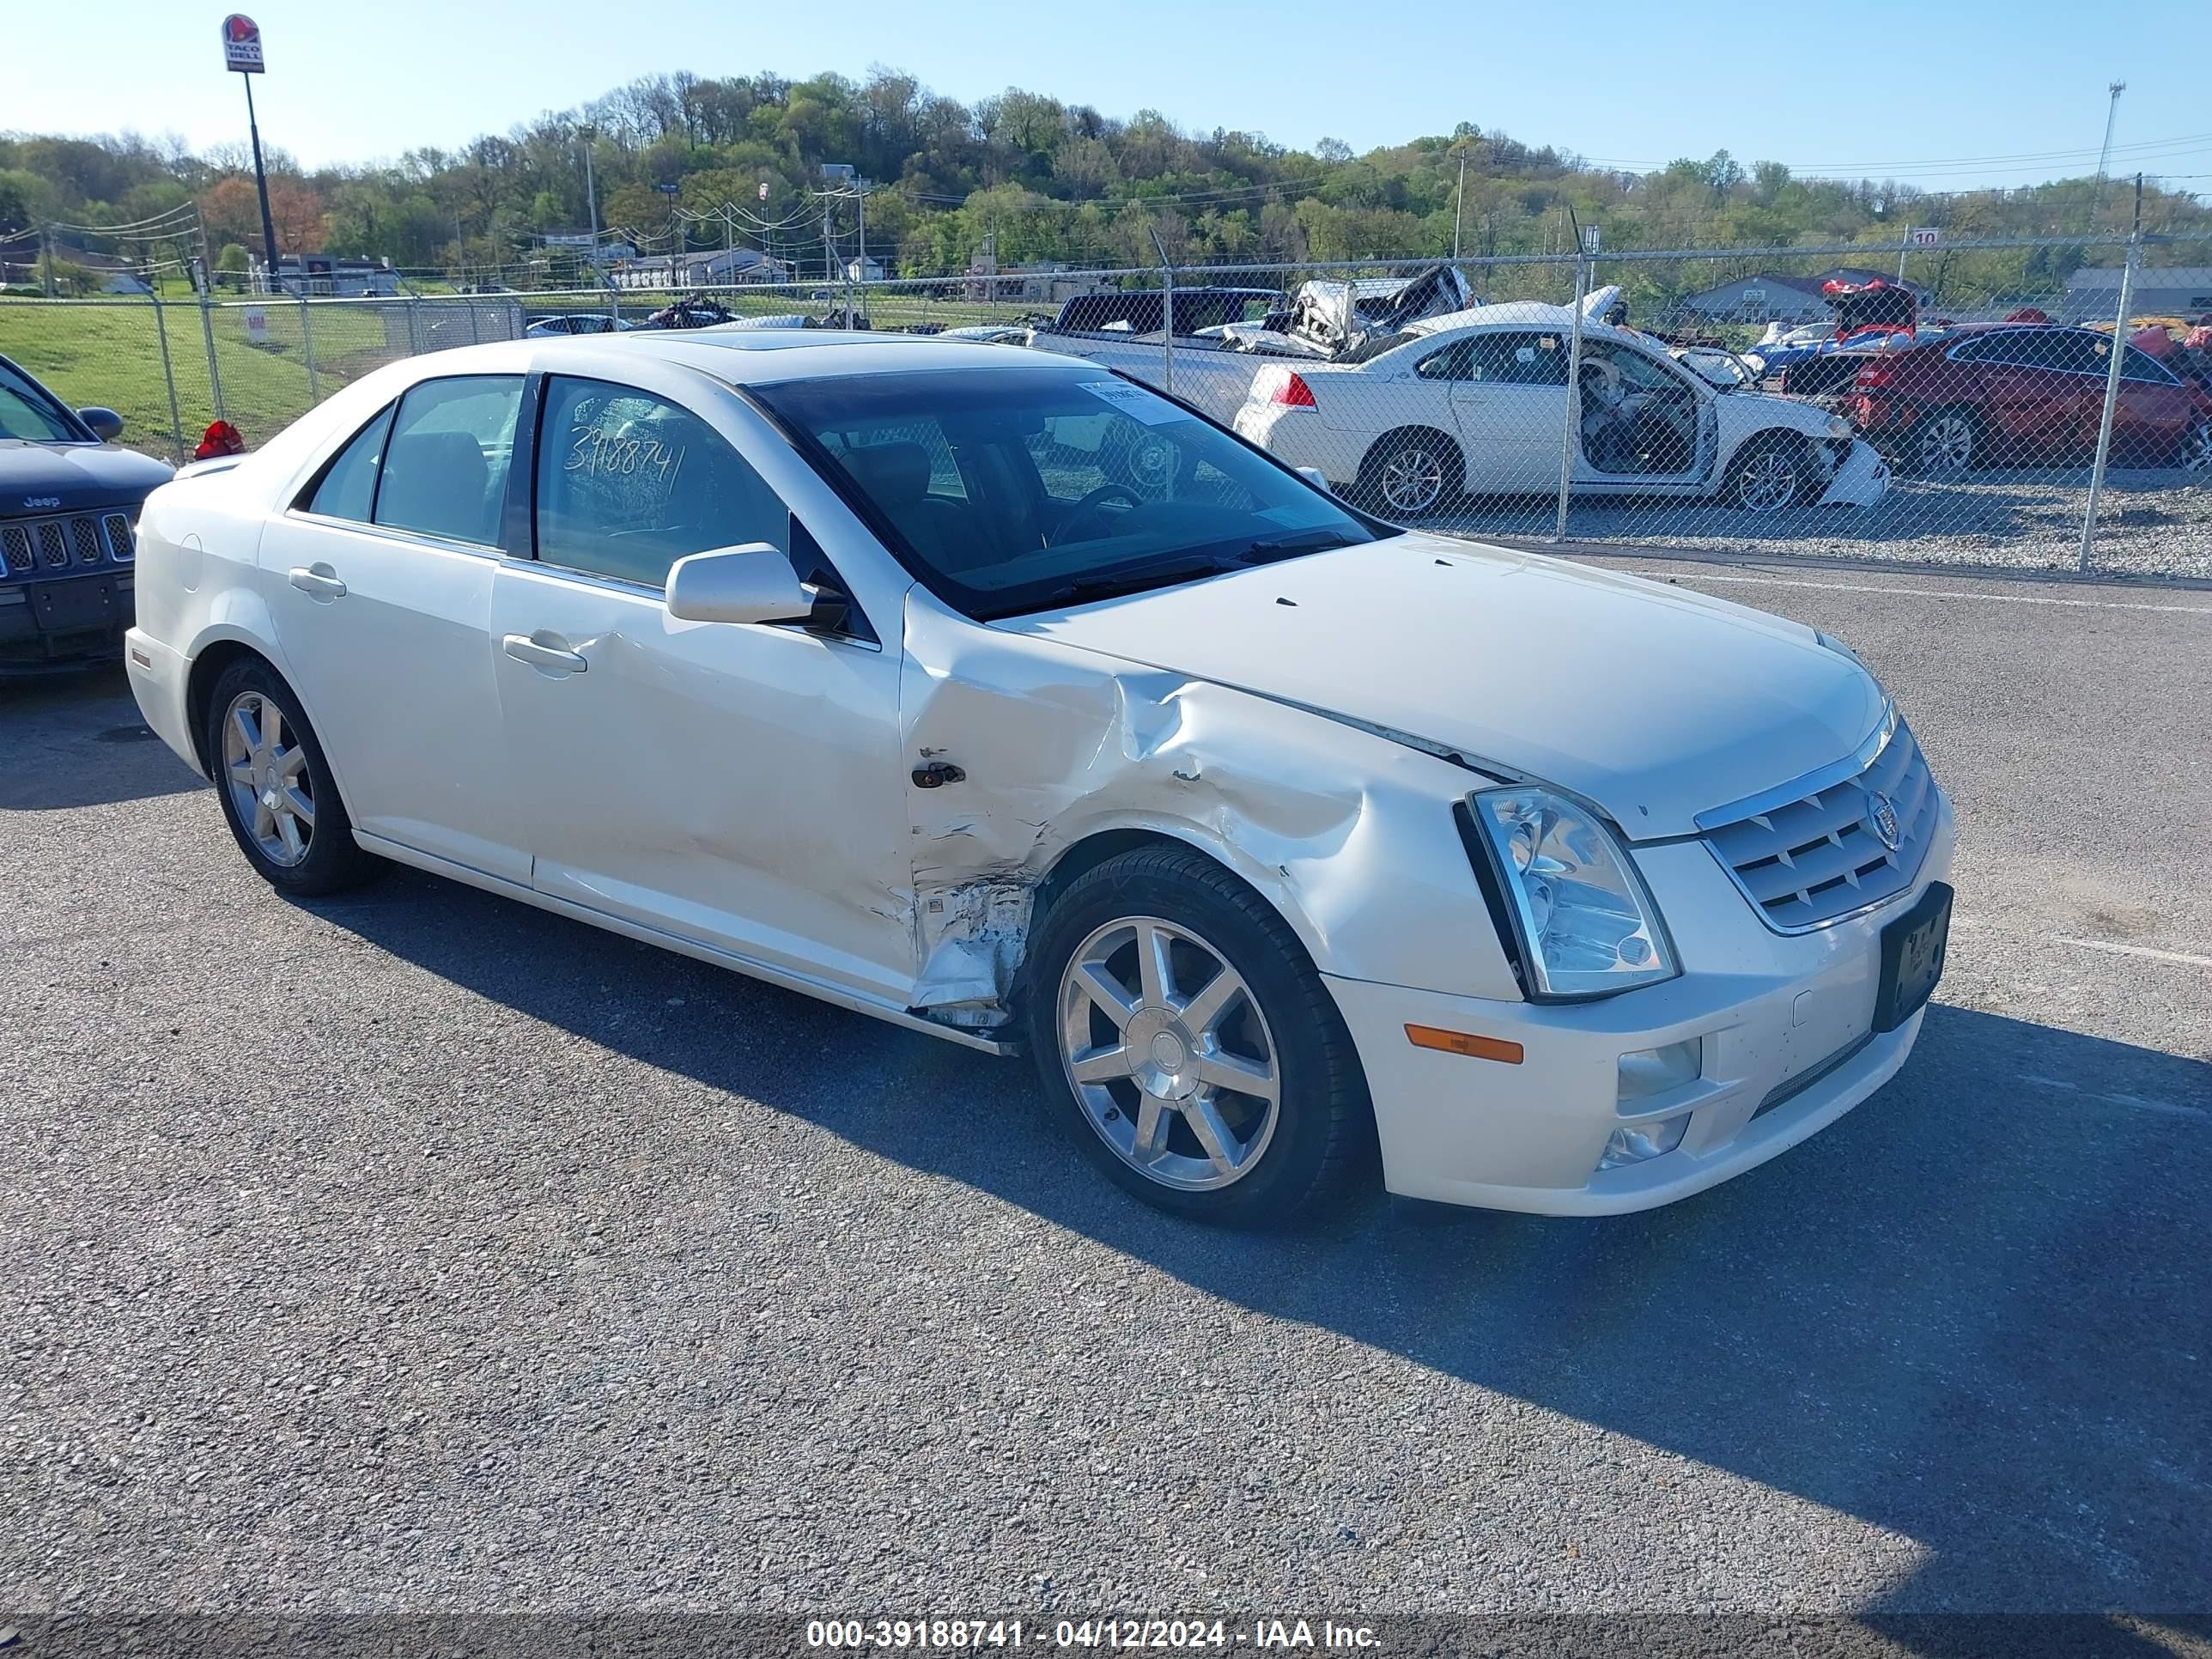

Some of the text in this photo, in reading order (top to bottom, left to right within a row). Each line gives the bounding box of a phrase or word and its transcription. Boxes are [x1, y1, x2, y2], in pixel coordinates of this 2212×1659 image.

[1916, 232, 1936, 243] 10
[563, 425, 686, 495] 39188741
[22, 496, 61, 508] Jeep
